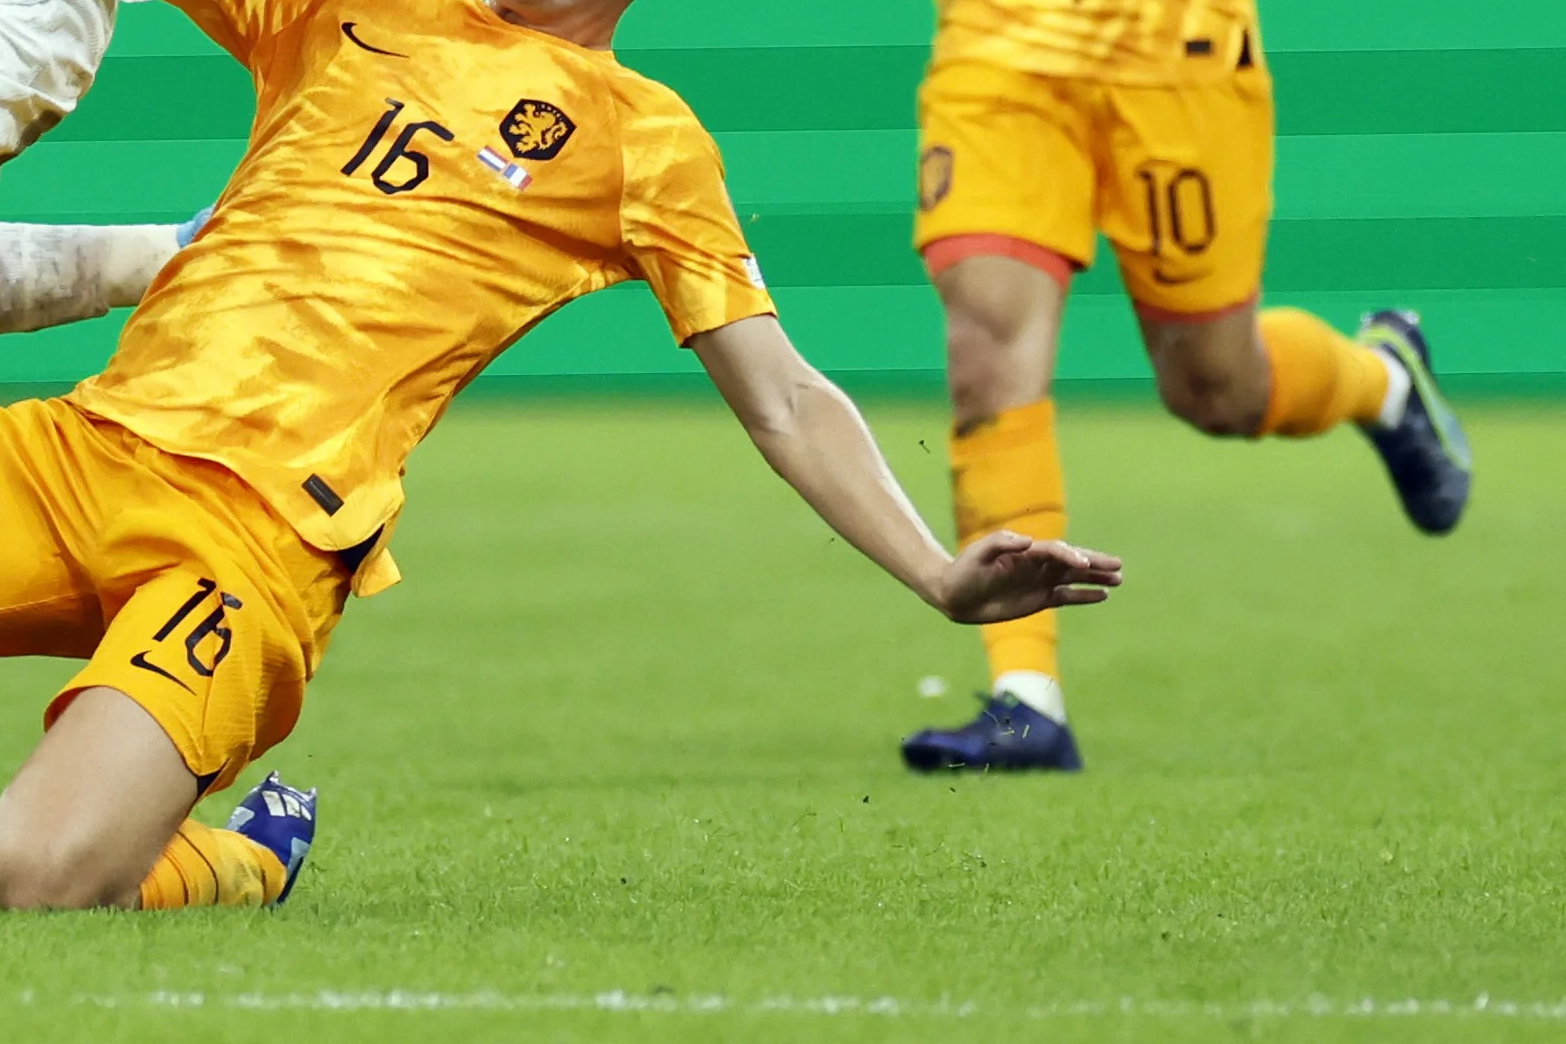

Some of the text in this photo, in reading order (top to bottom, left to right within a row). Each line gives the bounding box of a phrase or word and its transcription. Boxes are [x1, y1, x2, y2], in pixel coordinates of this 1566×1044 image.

[340, 96, 455, 195] 16
[1136, 166, 1215, 257] 10
[151, 578, 243, 678] 16
